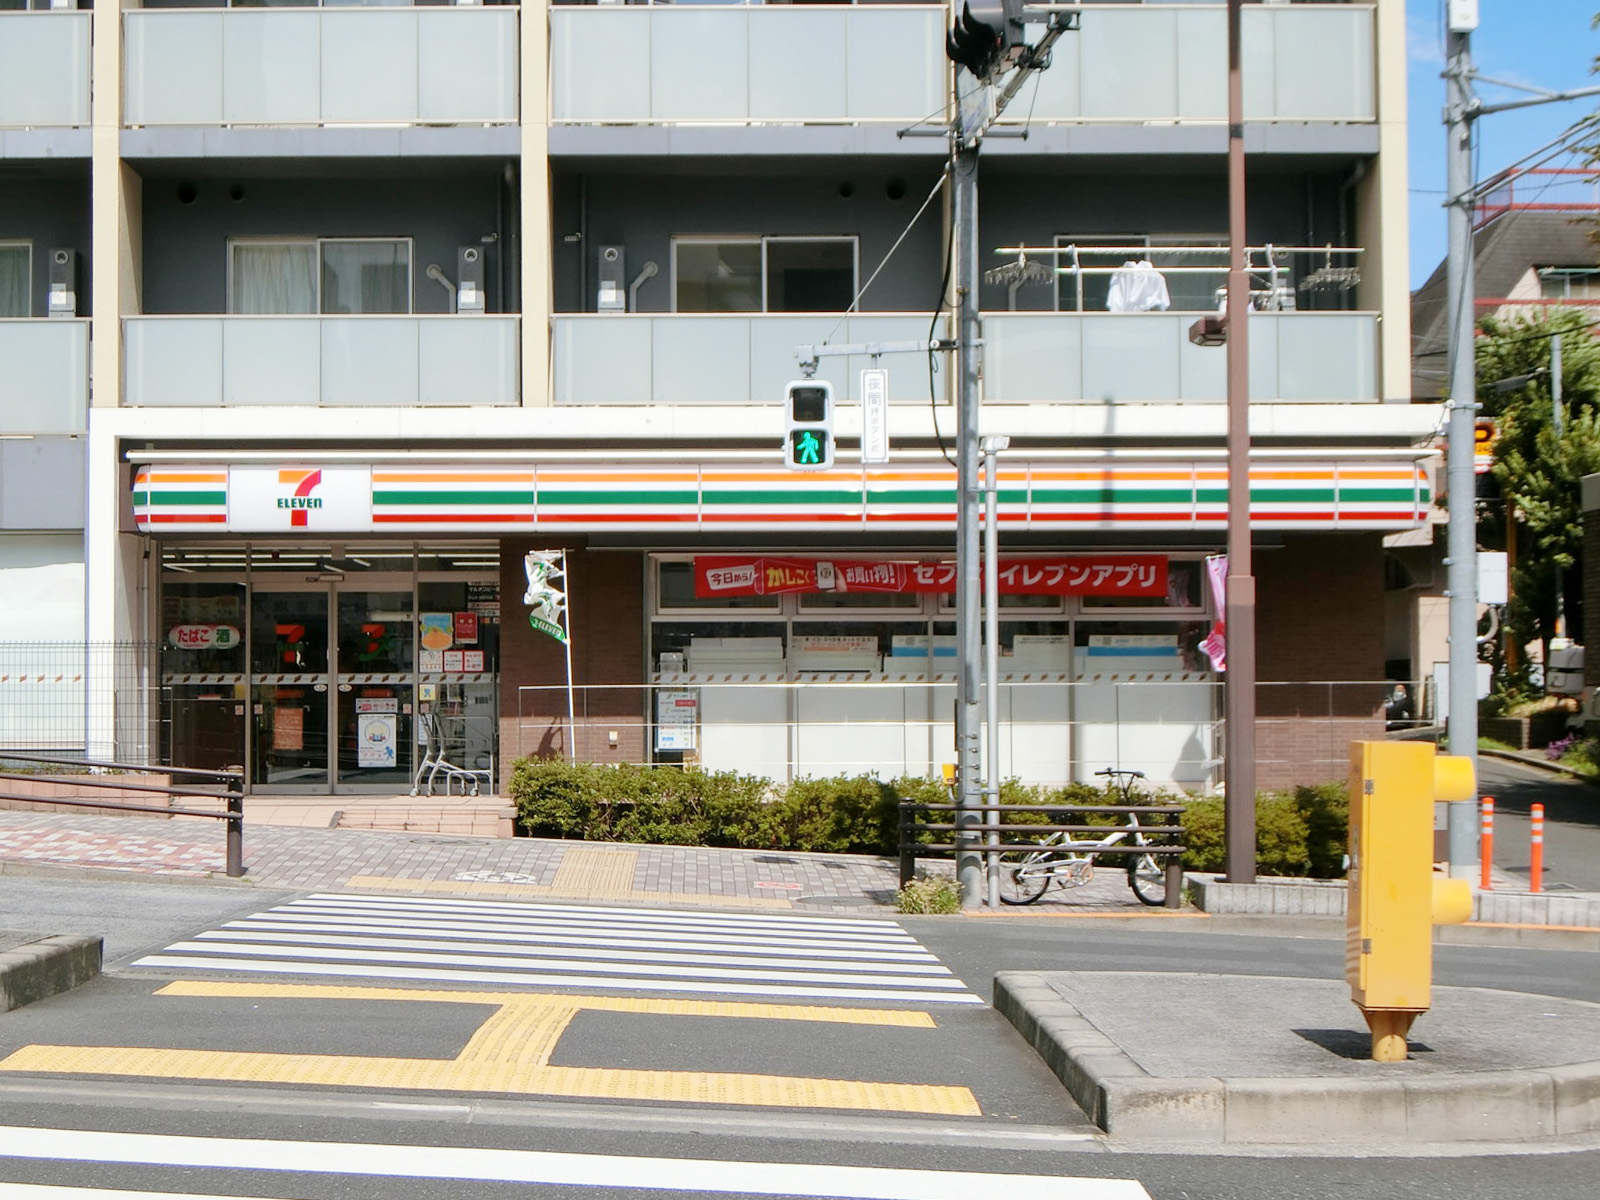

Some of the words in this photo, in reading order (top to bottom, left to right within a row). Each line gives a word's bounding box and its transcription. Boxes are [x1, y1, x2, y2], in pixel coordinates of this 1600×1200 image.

[279, 468, 321, 526] 7
[767, 567, 810, 587] かしこく
[913, 563, 1157, 588] セブイレブンアプリ
[178, 628, 210, 643] たばこ
[216, 628, 230, 643] 酒
